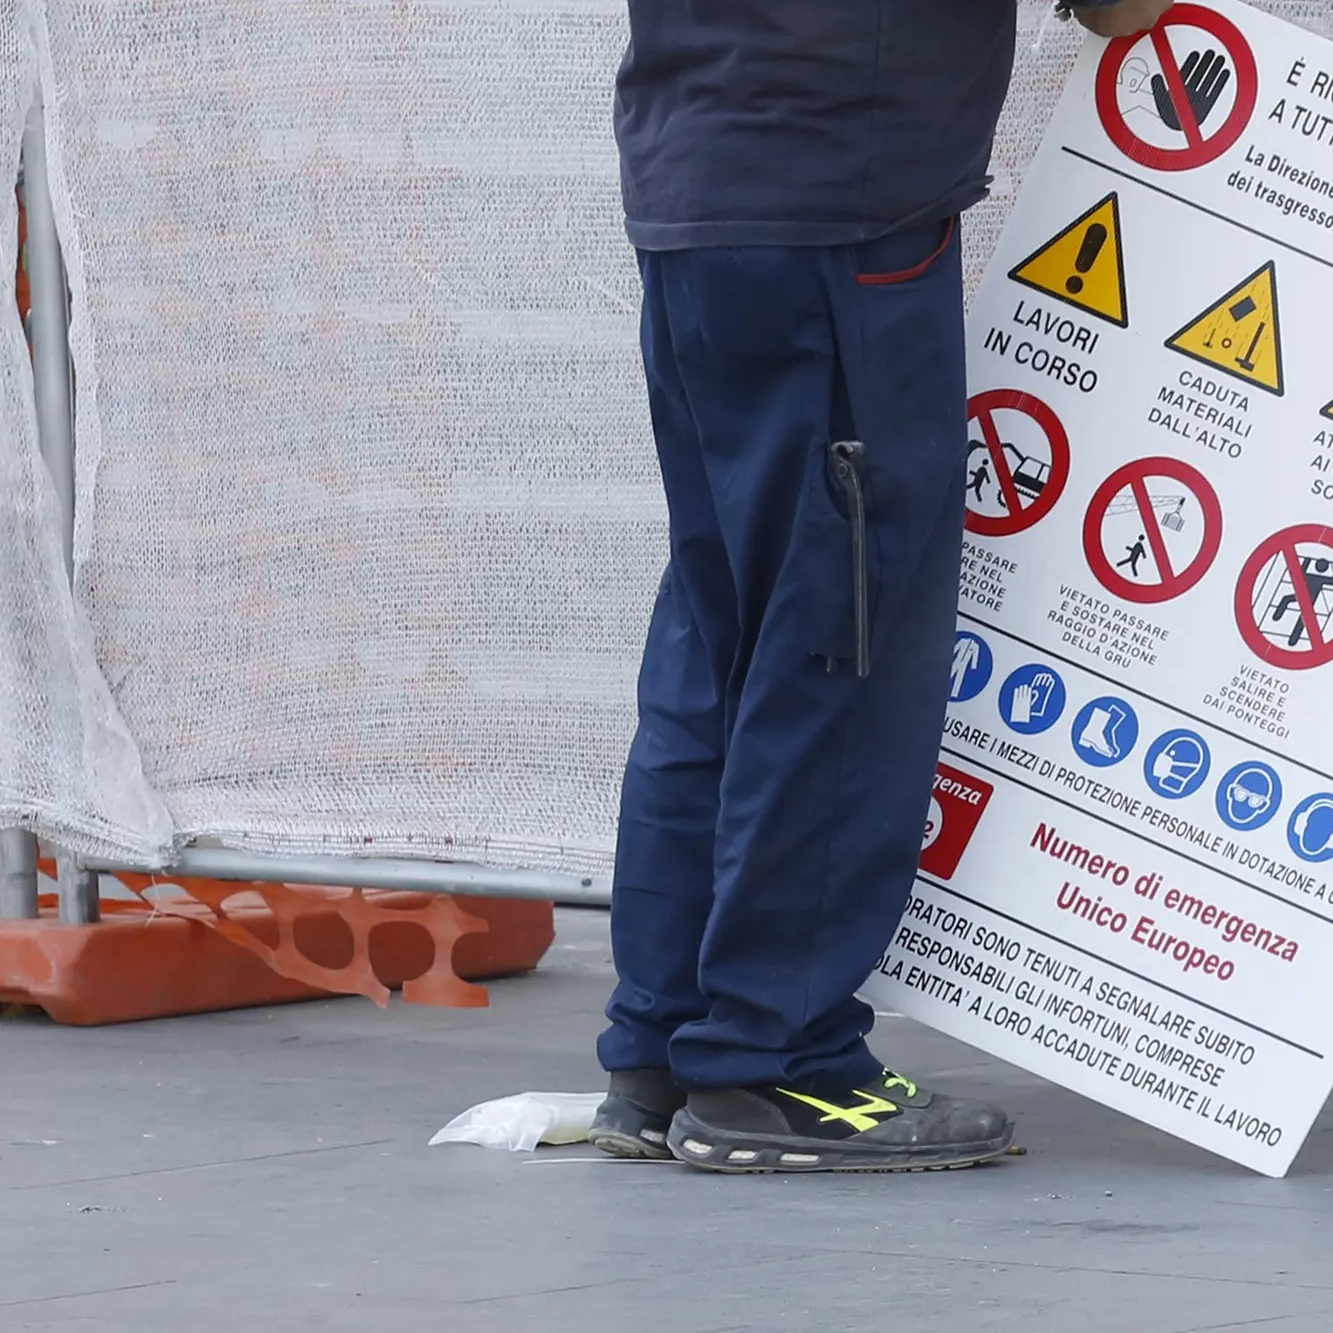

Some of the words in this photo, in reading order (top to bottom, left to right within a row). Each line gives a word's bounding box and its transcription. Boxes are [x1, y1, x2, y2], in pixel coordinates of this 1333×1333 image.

[1268, 98, 1285, 123] A
[1244, 144, 1264, 166] La
[1227, 170, 1254, 192] dei
[1012, 300, 1098, 354] LAVORI
[983, 327, 1011, 355] IN
[1014, 341, 1097, 392] CORSO
[1157, 386, 1251, 437] MATERIALI
[1178, 370, 1248, 411] CADUTA
[1147, 407, 1241, 457] DALL'ALTO
[1310, 454, 1330, 471] AI
[979, 564, 1001, 582] NEL
[1047, 609, 1096, 637] RAGGIO
[1059, 584, 1109, 614] VIETATO
[1112, 608, 1168, 640] PASSARE
[1060, 600, 1069, 611] E
[1071, 605, 1128, 637] SOSTARE
[1130, 632, 1153, 649] NEL
[1061, 631, 1100, 655] DELLA
[1104, 650, 1131, 668] GRU
[1230, 675, 1274, 702] SALIRE
[1276, 696, 1285, 707] E
[1240, 664, 1289, 693] VIETATO
[1202, 693, 1225, 710] DAI
[1226, 704, 1289, 738] PONTEGGI
[1219, 686, 1285, 721] SCENDERE
[943, 715, 990, 749] USARE
[988, 737, 997, 752] I
[995, 740, 1039, 771] MEZZI
[1038, 759, 1055, 778] DI
[1054, 767, 1141, 816] PROTEZIONE
[1140, 805, 1222, 852] PERSONALE
[1222, 841, 1238, 859] IN
[1238, 849, 1315, 893] DOTAZIONE
[1314, 883, 1325, 898] A
[1030, 822, 1129, 885] Numero
[1134, 872, 1162, 899] di
[1164, 889, 1298, 961] emergenza
[1056, 881, 1127, 932] Unico
[1131, 915, 1234, 980] Europeo
[895, 925, 1014, 993] RESPONSABILI
[1014, 980, 1044, 1006] GLI
[1043, 993, 1130, 1046] INFORTUNI,
[1135, 1034, 1224, 1086] COMPRESE
[972, 926, 1020, 961] SONO
[1023, 947, 1081, 987] TENUTI
[1079, 976, 1093, 994] A
[1095, 982, 1195, 1038] SEGNALARE
[1194, 1026, 1254, 1064] SUBITO
[967, 995, 982, 1015] A
[983, 1001, 1031, 1035] LORO
[1031, 1024, 1120, 1075] ACCADUTE
[1120, 1062, 1198, 1109] DURANTE
[1196, 1096, 1210, 1117] IL
[1214, 1105, 1281, 1146] LAVORO
